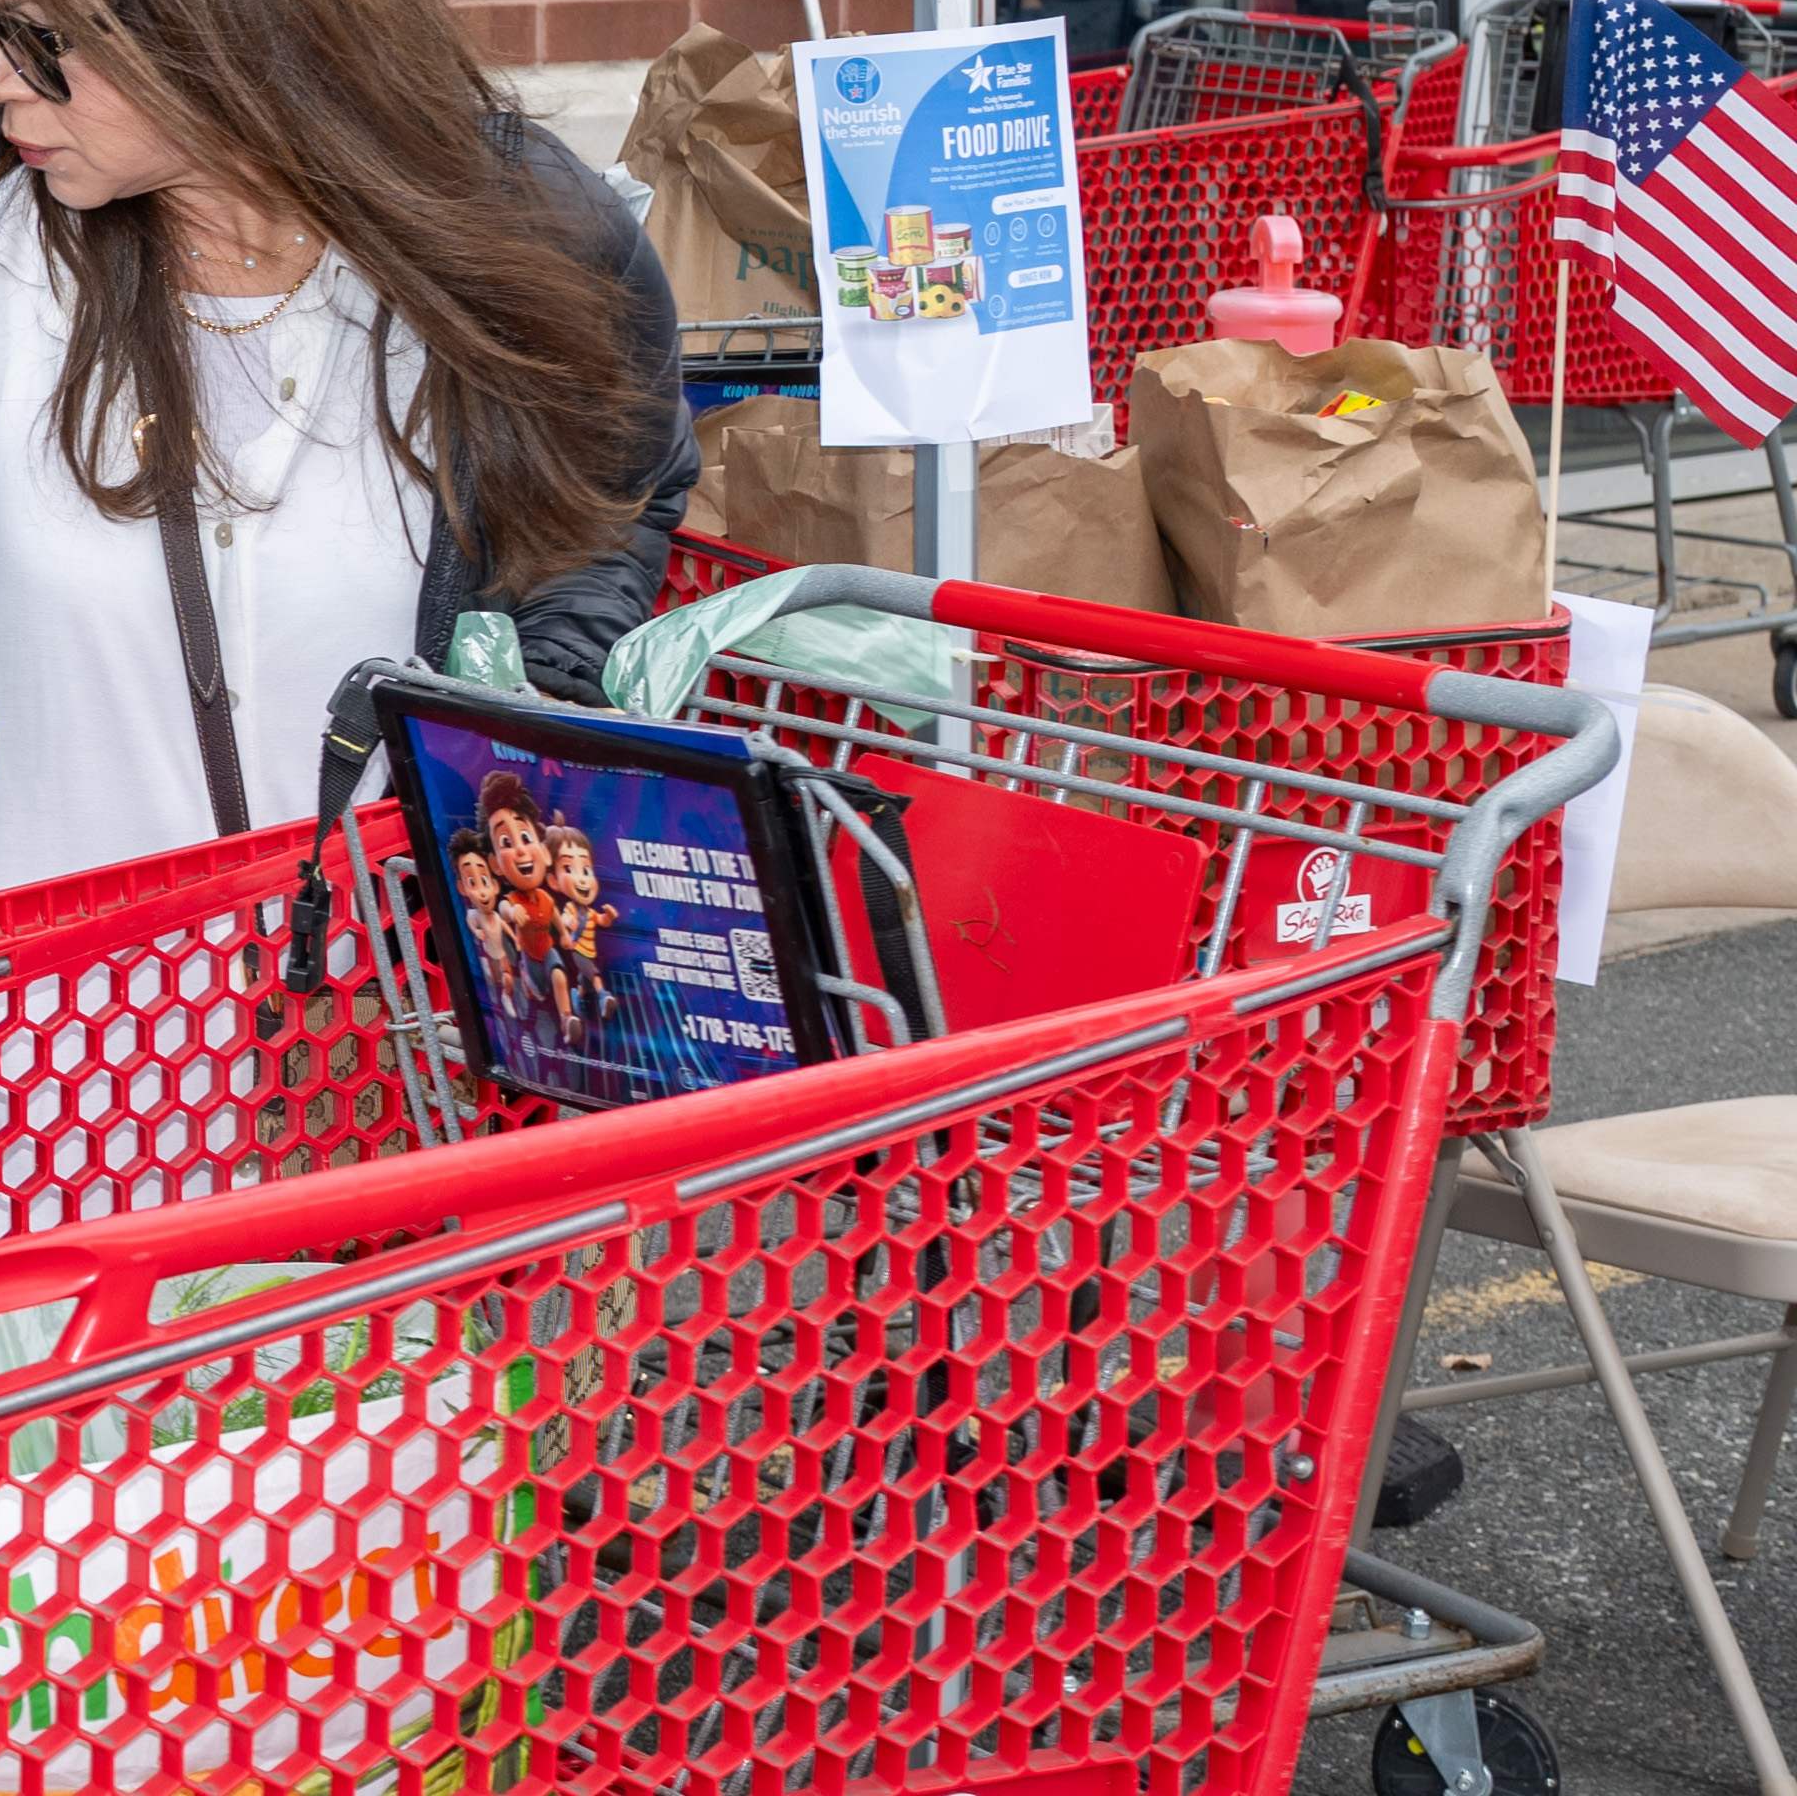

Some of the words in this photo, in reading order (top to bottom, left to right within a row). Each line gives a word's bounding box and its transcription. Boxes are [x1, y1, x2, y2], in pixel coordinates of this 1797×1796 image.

[996, 64, 1016, 76] Blue
[1017, 62, 1033, 74] Star
[996, 75, 1032, 89] Families
[822, 102, 902, 126] Nourish
[825, 125, 848, 140] the
[850, 122, 902, 138] Service
[942, 123, 999, 160] FOOD
[1002, 114, 1051, 153] DRIVE
[617, 838, 689, 872] WELCOME
[687, 847, 710, 874] TO
[710, 851, 736, 879] THE
[631, 870, 703, 905] ULTIMATE
[704, 878, 733, 908] FUN
